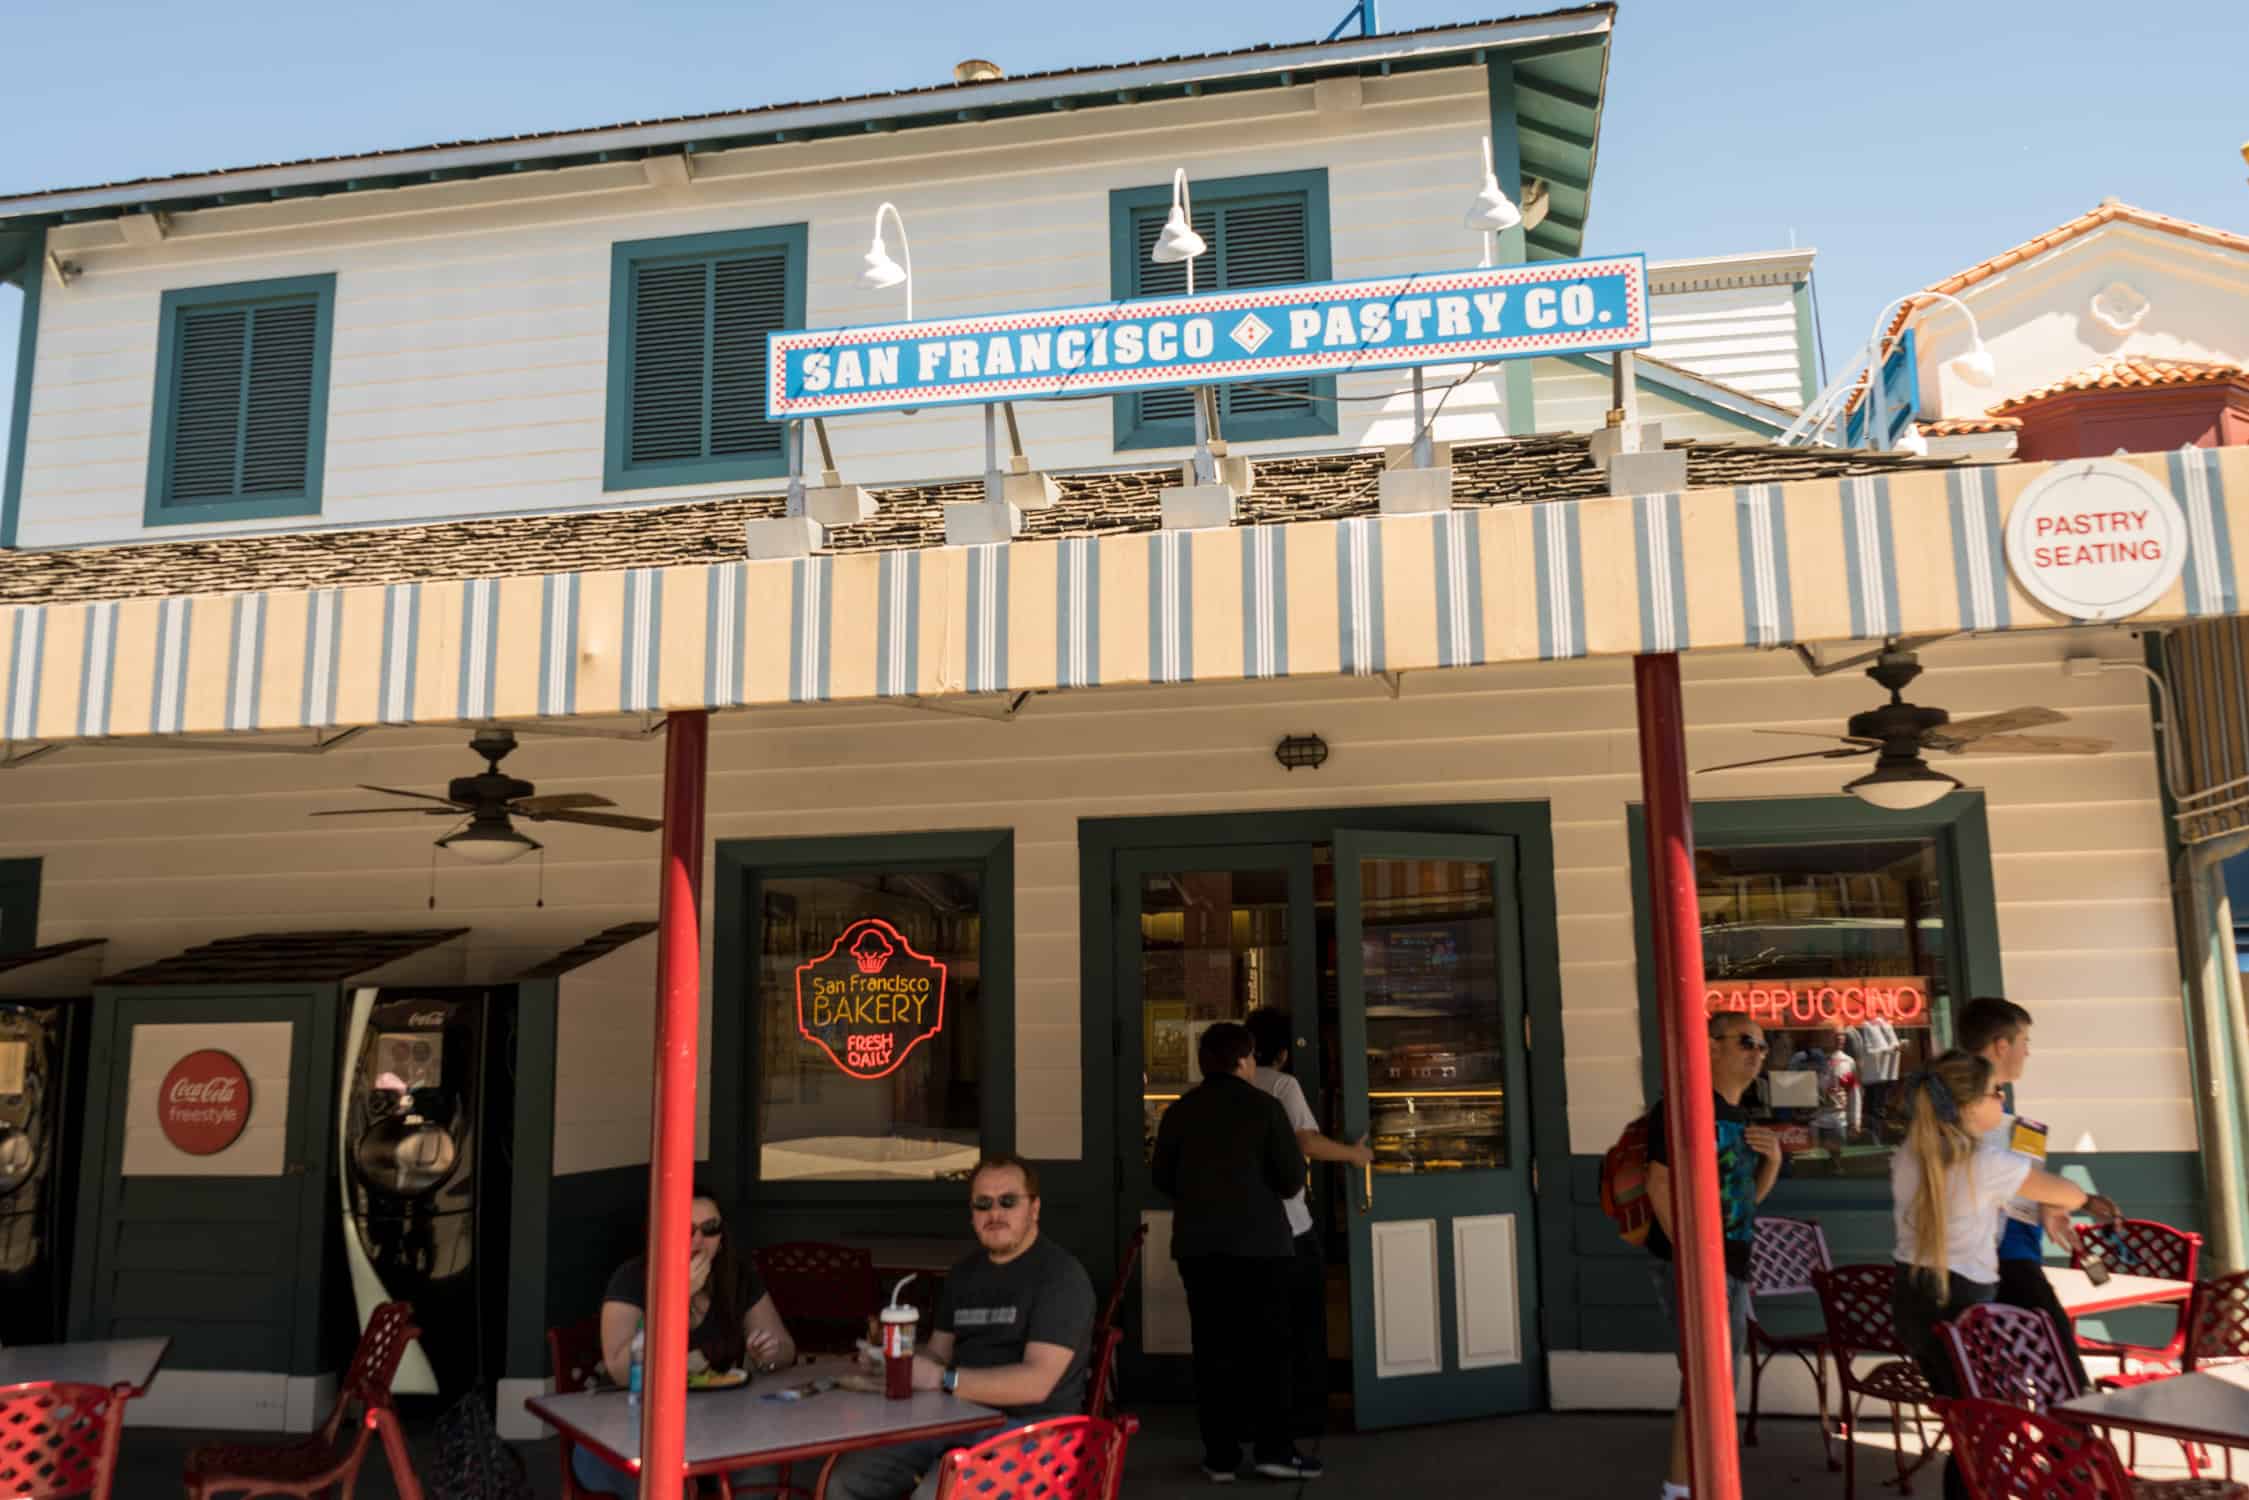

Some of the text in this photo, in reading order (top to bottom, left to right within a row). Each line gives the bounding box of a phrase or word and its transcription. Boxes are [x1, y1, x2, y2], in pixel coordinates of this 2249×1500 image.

[802, 284, 1612, 391] SAN FRANCISCO PASTRY CO.
[2036, 510, 2148, 537] PASTRY
[2034, 540, 2161, 568] SEATING
[813, 974, 930, 995] San Francisco
[813, 993, 929, 1027] BAKERY
[847, 1032, 894, 1051] FRESH
[847, 1049, 893, 1068] DAILY
[169, 1106, 237, 1126] freestyle
